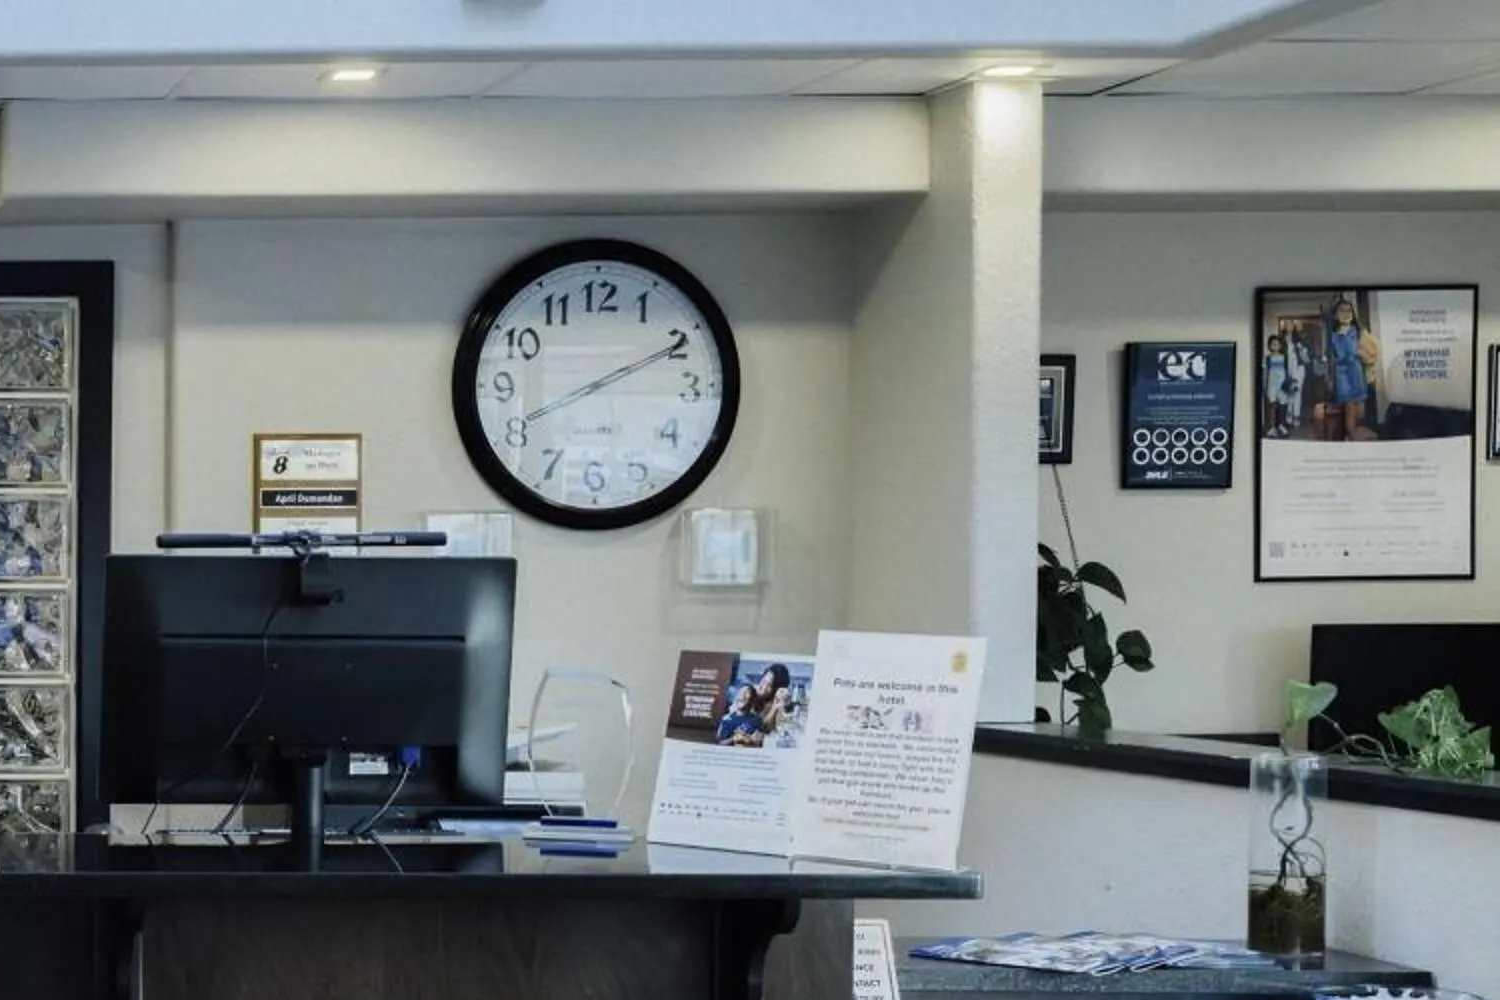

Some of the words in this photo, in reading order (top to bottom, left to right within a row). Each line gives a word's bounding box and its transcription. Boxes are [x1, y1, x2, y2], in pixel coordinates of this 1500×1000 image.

[542, 292, 570, 326] 11
[582, 280, 618, 312] 12
[636, 291, 649, 324] 1
[505, 326, 541, 361] 10
[667, 328, 689, 360] 2
[493, 371, 515, 402] 9
[678, 371, 701, 402] 3
[505, 416, 527, 448] 8
[660, 418, 680, 449] 4
[541, 448, 564, 480] 7
[583, 461, 606, 492] 6
[627, 453, 648, 483] 5
